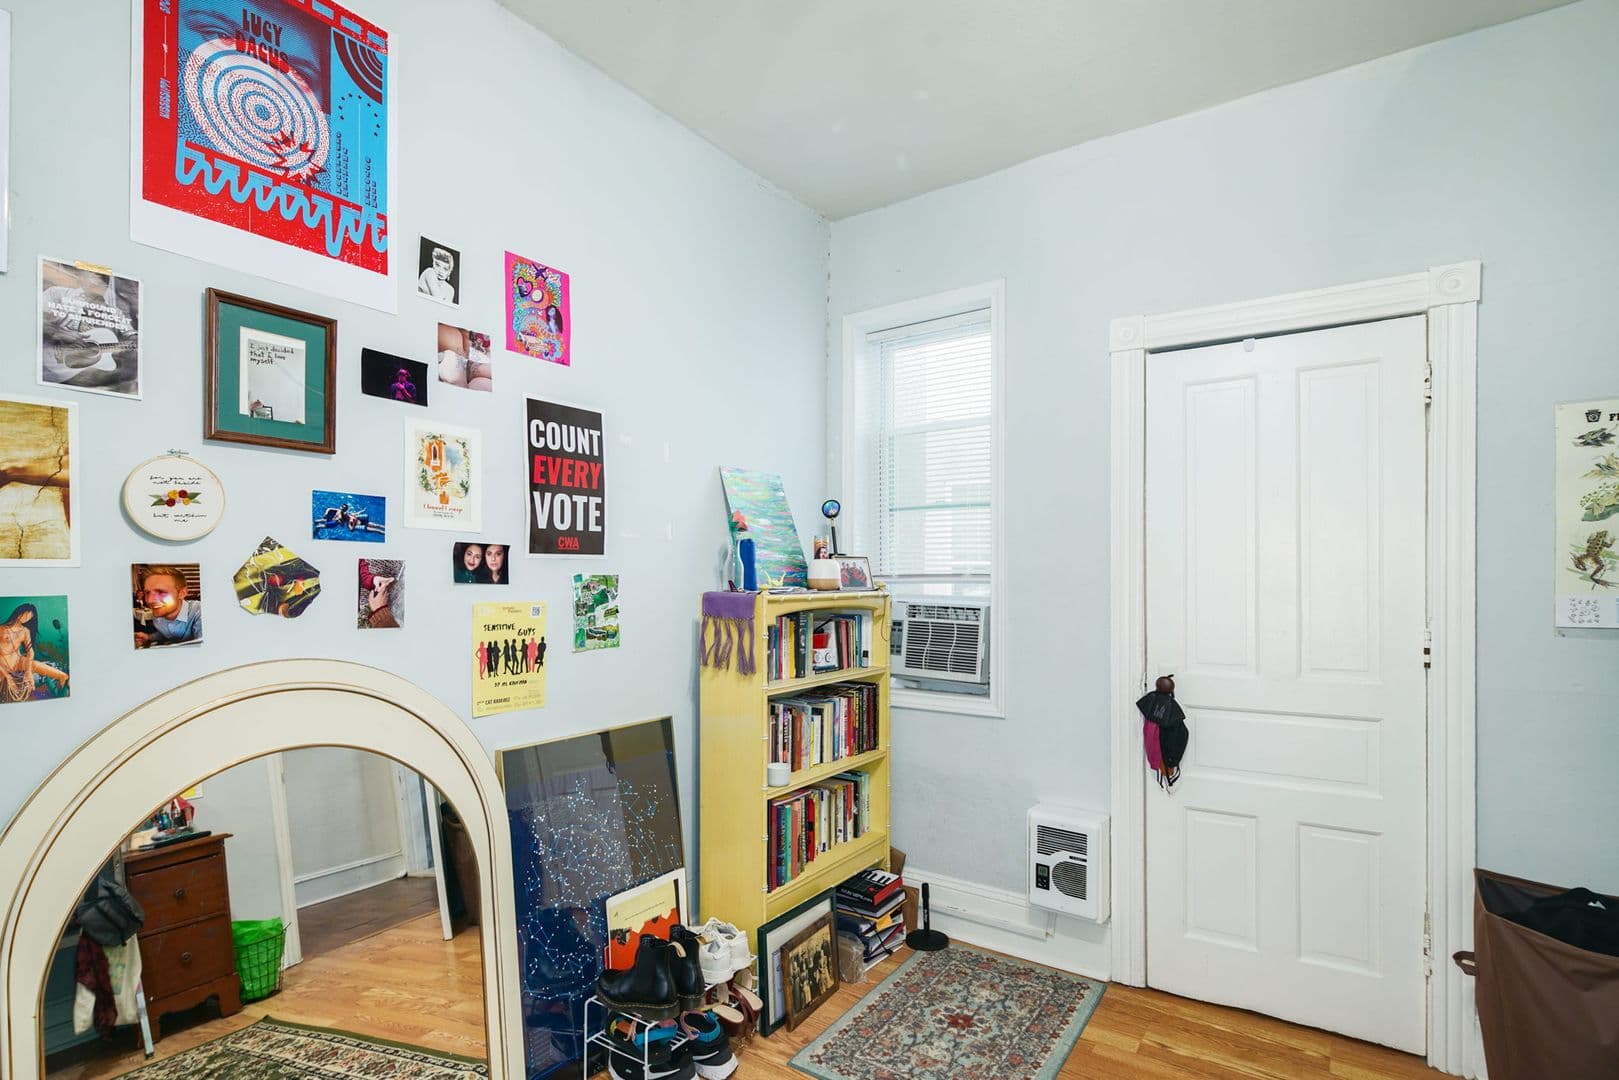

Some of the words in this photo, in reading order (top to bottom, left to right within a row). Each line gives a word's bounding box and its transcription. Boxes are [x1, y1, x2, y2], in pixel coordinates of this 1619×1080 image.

[242, 8, 283, 47] LUCY
[235, 29, 290, 73] DACUS
[52, 310, 66, 318] TO
[250, 350, 265, 358] that
[530, 418, 600, 457] COUNT
[532, 454, 602, 490] EVERY
[532, 491, 602, 532] VOTE
[558, 536, 579, 549] CWA
[483, 623, 516, 631] SENSITIVE
[517, 627, 536, 637] GUYS
